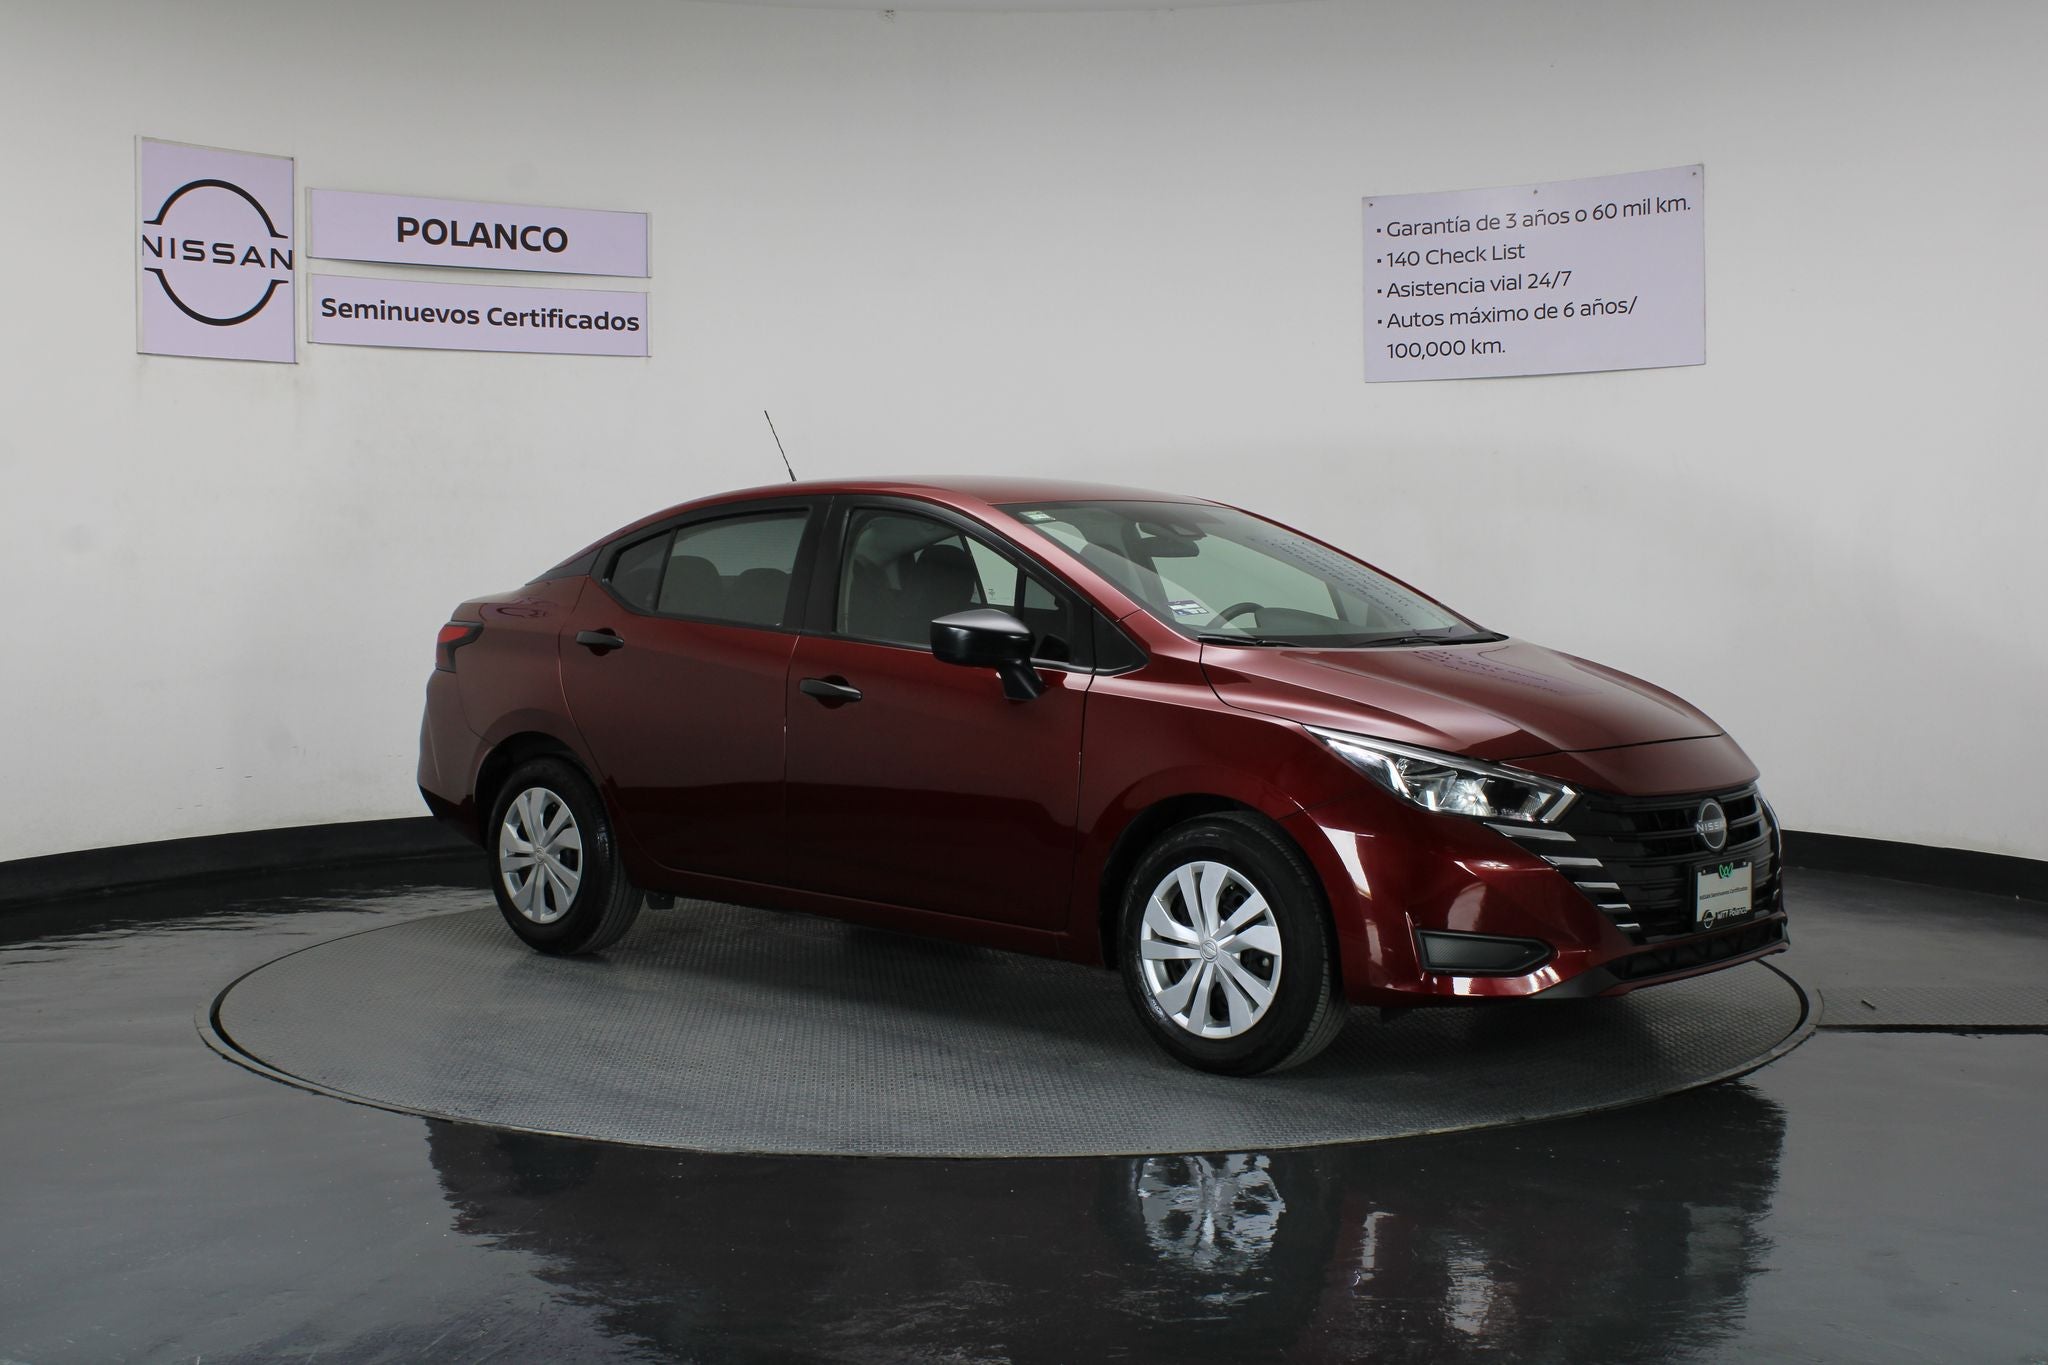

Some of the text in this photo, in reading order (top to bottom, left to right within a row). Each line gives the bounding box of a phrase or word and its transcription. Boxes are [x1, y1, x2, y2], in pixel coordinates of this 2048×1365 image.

[1386, 196, 1691, 238] Garantía de 3 años o 60 mil km.
[397, 216, 568, 254] POLANCO
[142, 234, 293, 271] NISSAN
[1386, 243, 1526, 268] 140 Check List
[1386, 270, 1573, 299] Asistencia vial 24/7
[321, 297, 640, 332] Seminuevos Certificados
[1386, 295, 1638, 329] Autos máximo de 6 años/
[1386, 338, 1506, 361] 100,000 km.
[1696, 819, 1726, 833] NISS
